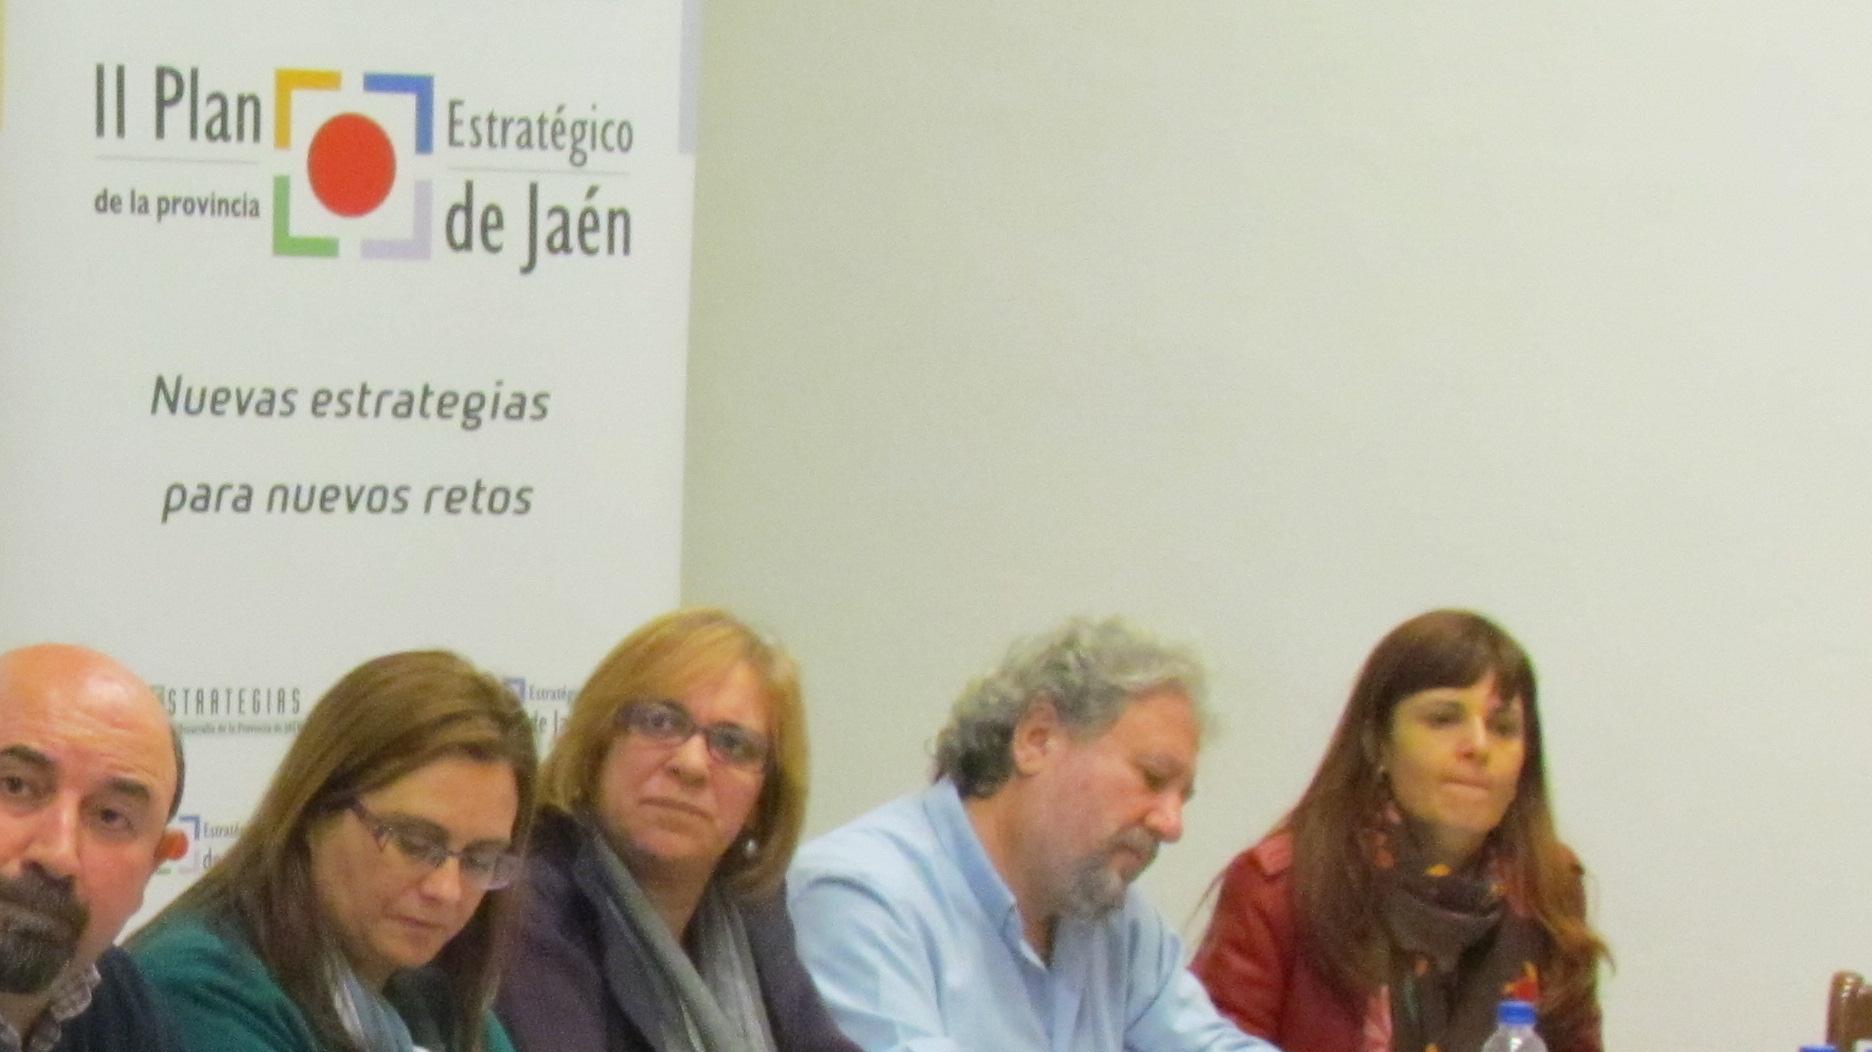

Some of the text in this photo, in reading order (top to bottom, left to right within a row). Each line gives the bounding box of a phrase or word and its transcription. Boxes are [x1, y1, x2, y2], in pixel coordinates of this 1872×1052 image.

[95, 63, 262, 144] II Plan
[447, 98, 634, 169] Estratégico
[93, 187, 261, 223] de la provincia
[445, 179, 631, 276] de Jaén
[150, 374, 551, 432] Nuevas estrategias
[160, 478, 534, 524] para nuevos retos
[152, 686, 301, 716] STRATEGIAS
